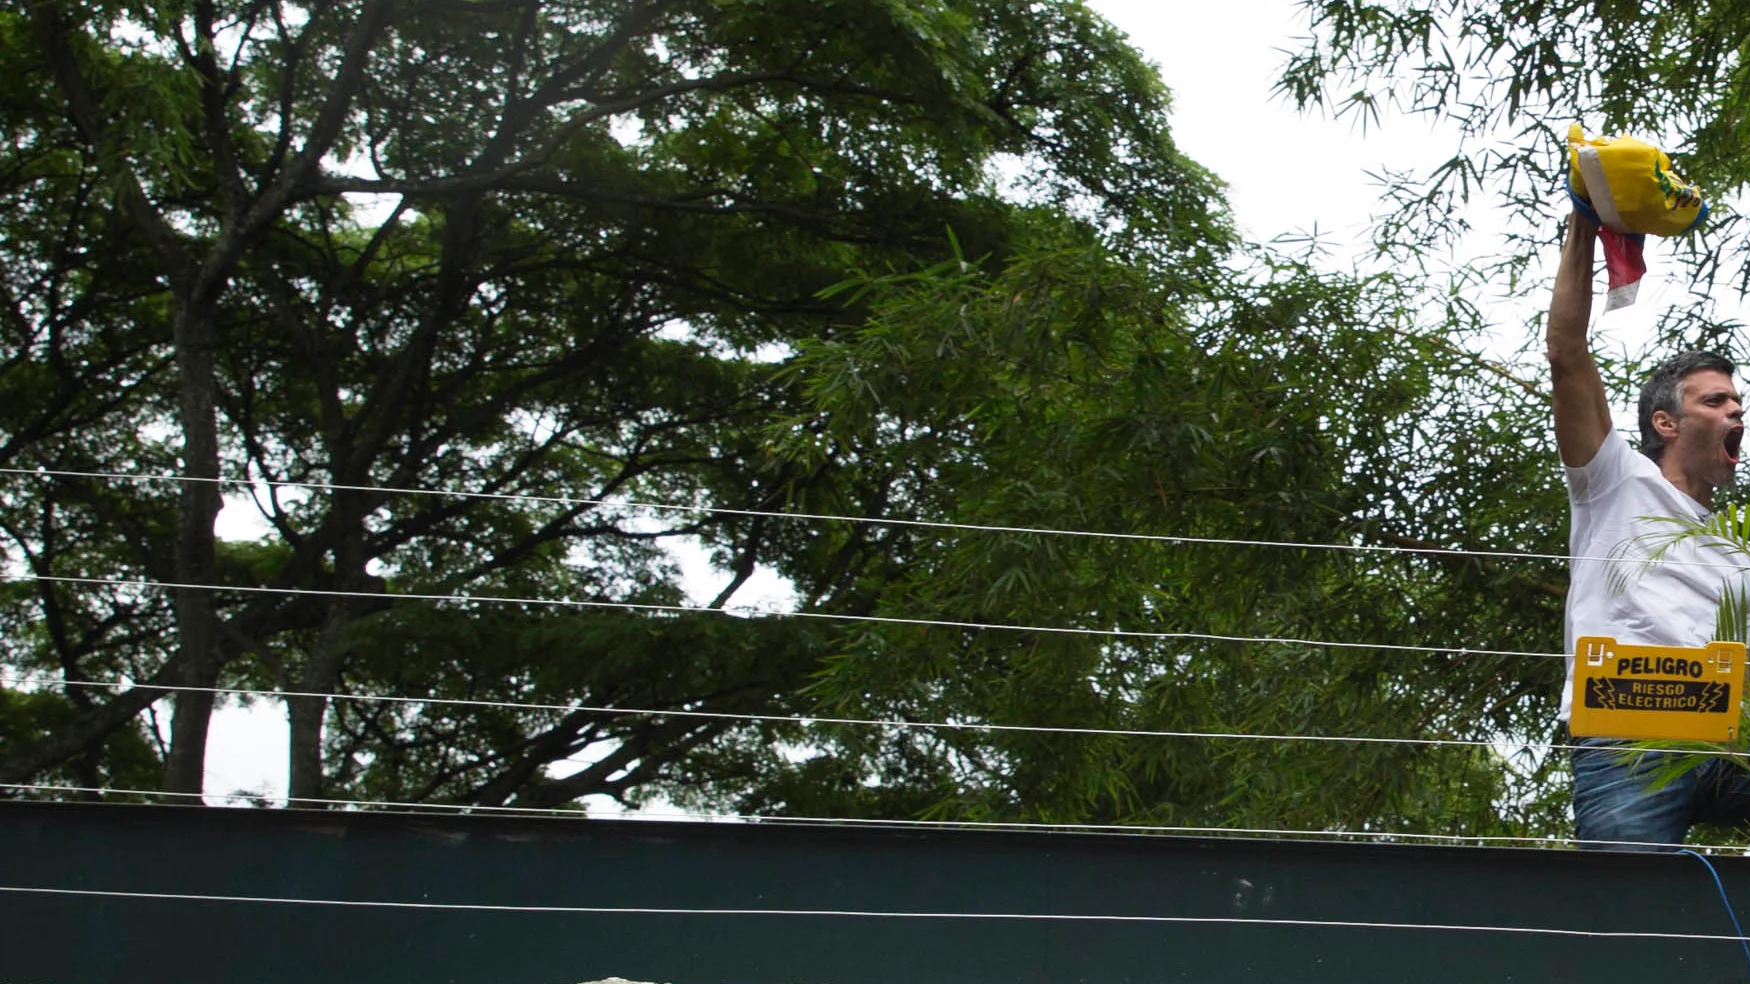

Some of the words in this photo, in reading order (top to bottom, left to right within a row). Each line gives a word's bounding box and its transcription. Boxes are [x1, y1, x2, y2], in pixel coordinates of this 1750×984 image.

[1617, 657, 1703, 678] PELIGRO
[1632, 682, 1684, 695] RIESGO
[1618, 694, 1697, 708] ELECTRICO
